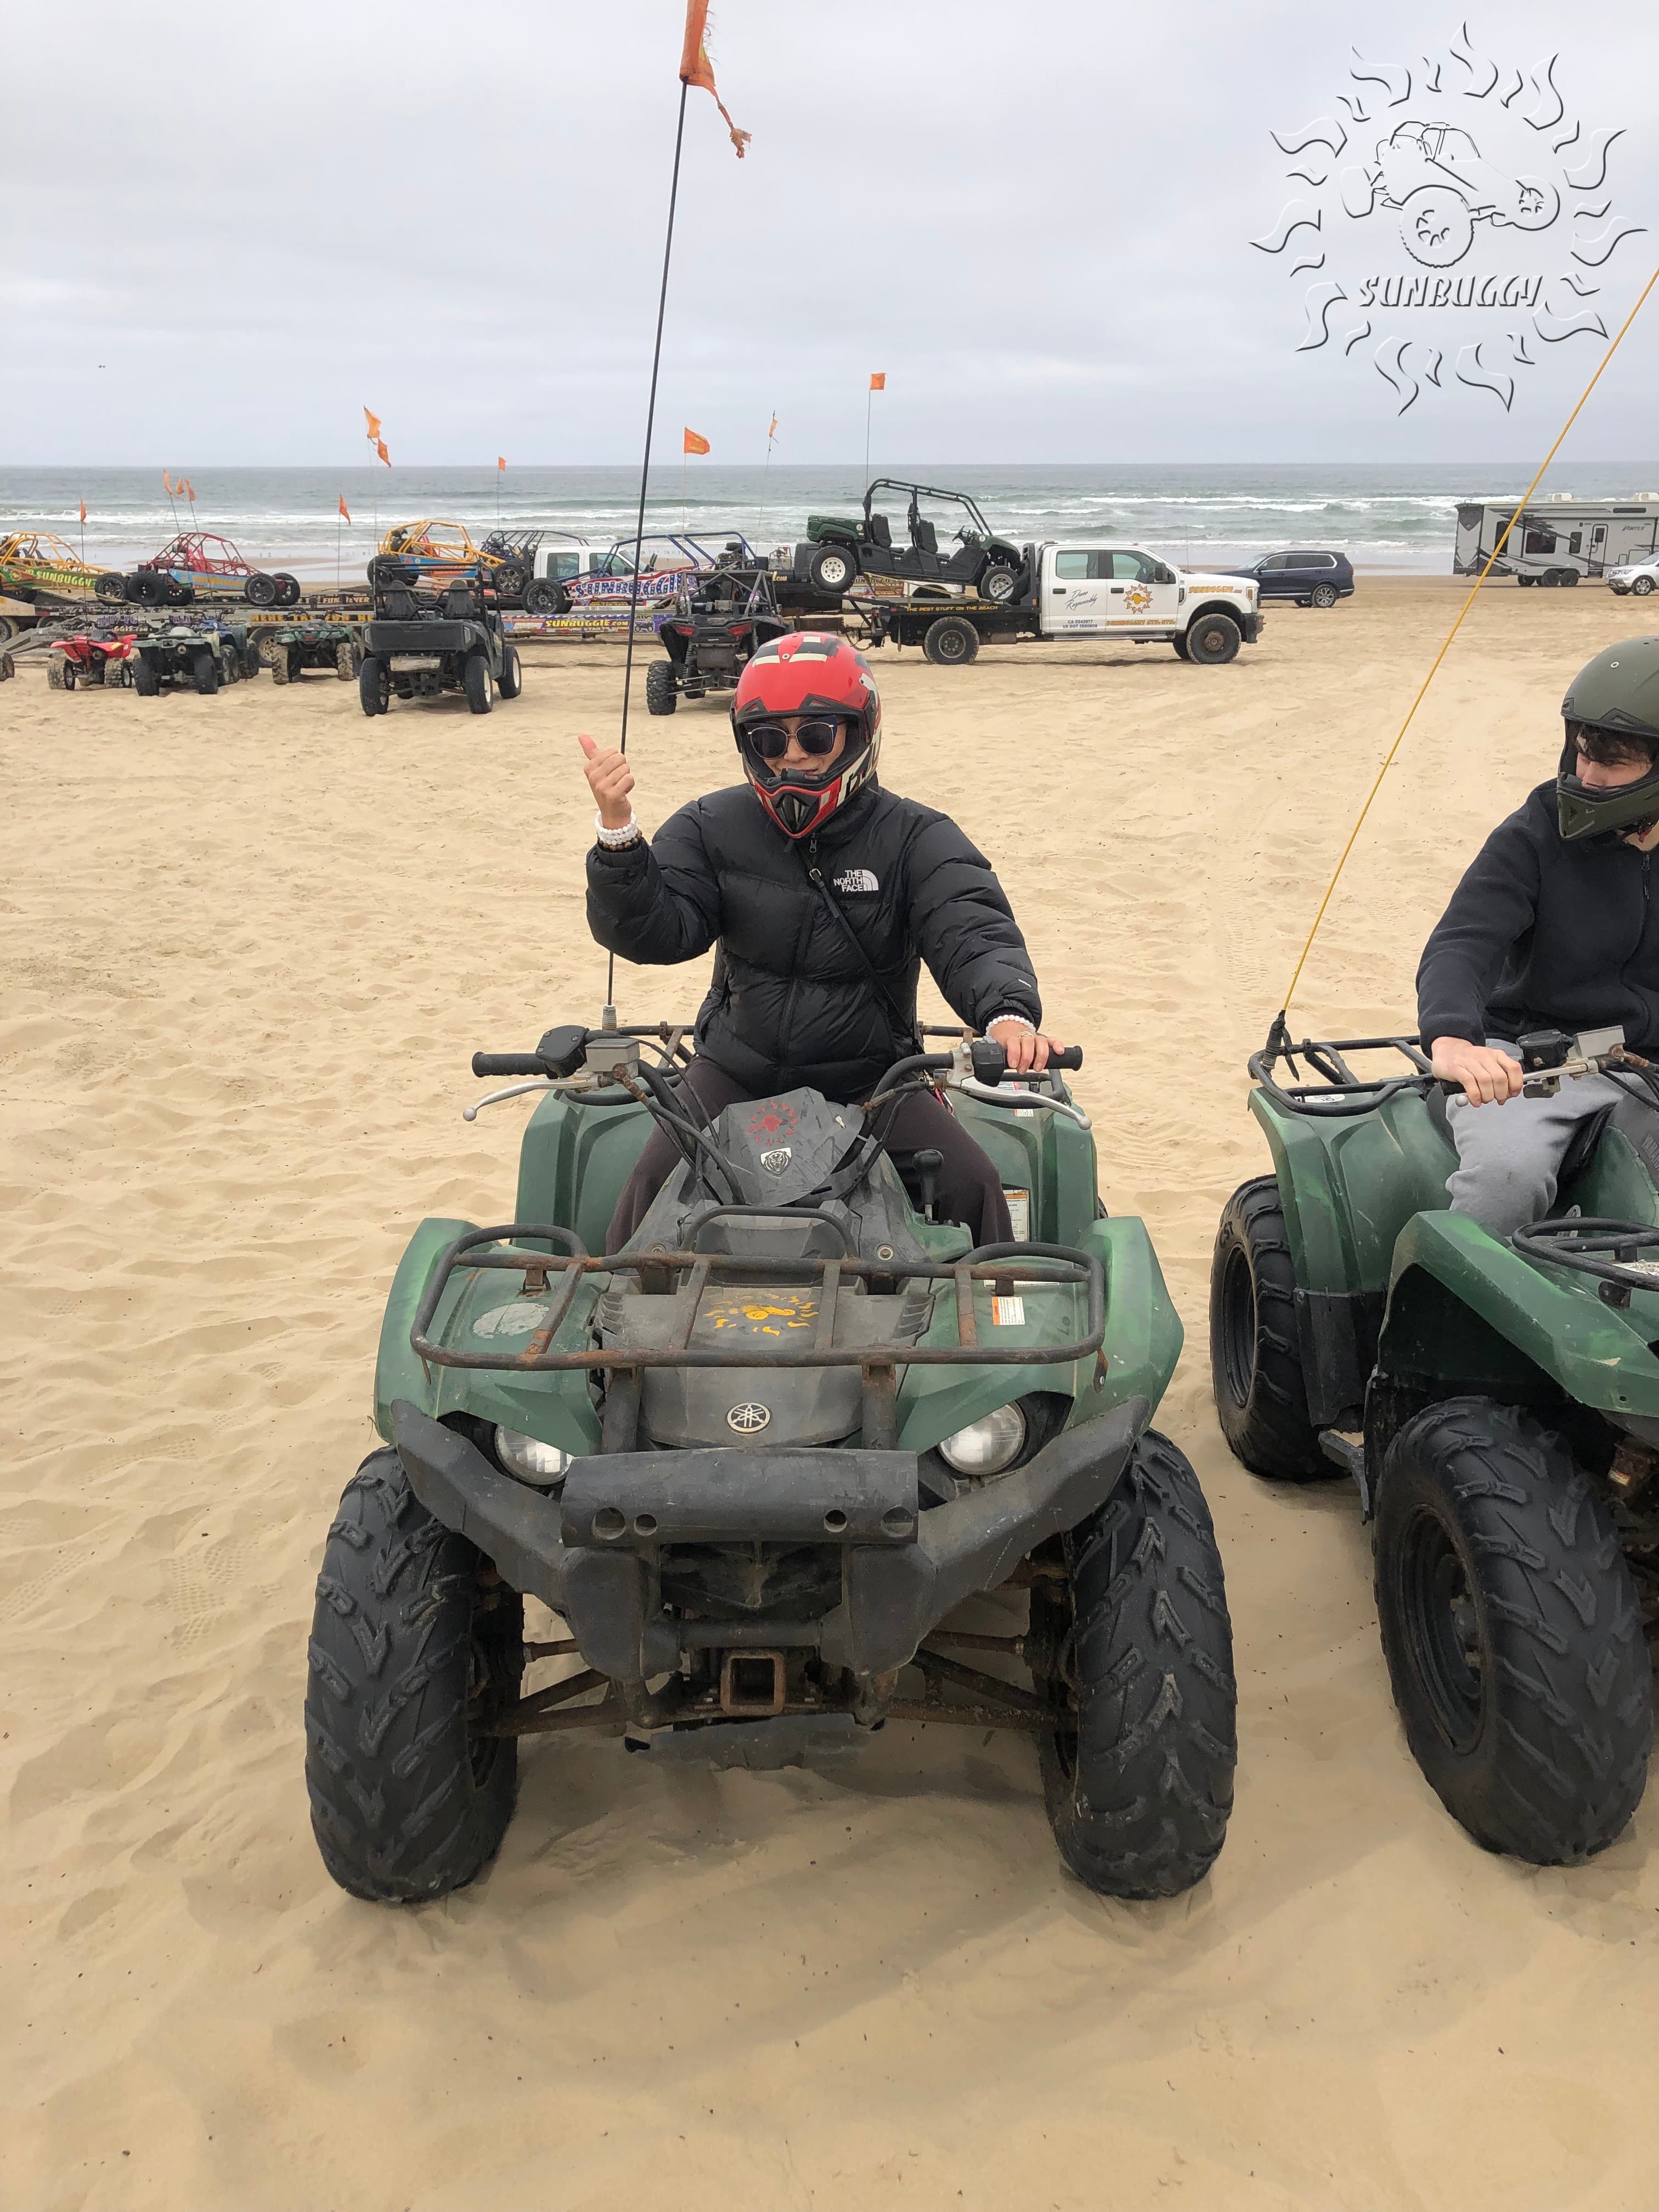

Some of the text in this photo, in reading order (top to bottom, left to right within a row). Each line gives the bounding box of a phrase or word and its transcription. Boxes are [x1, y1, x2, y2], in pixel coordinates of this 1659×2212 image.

[36, 569, 92, 587] SUNBUGGY
[845, 870, 862, 878] THE
[833, 877, 862, 886] NORTH
